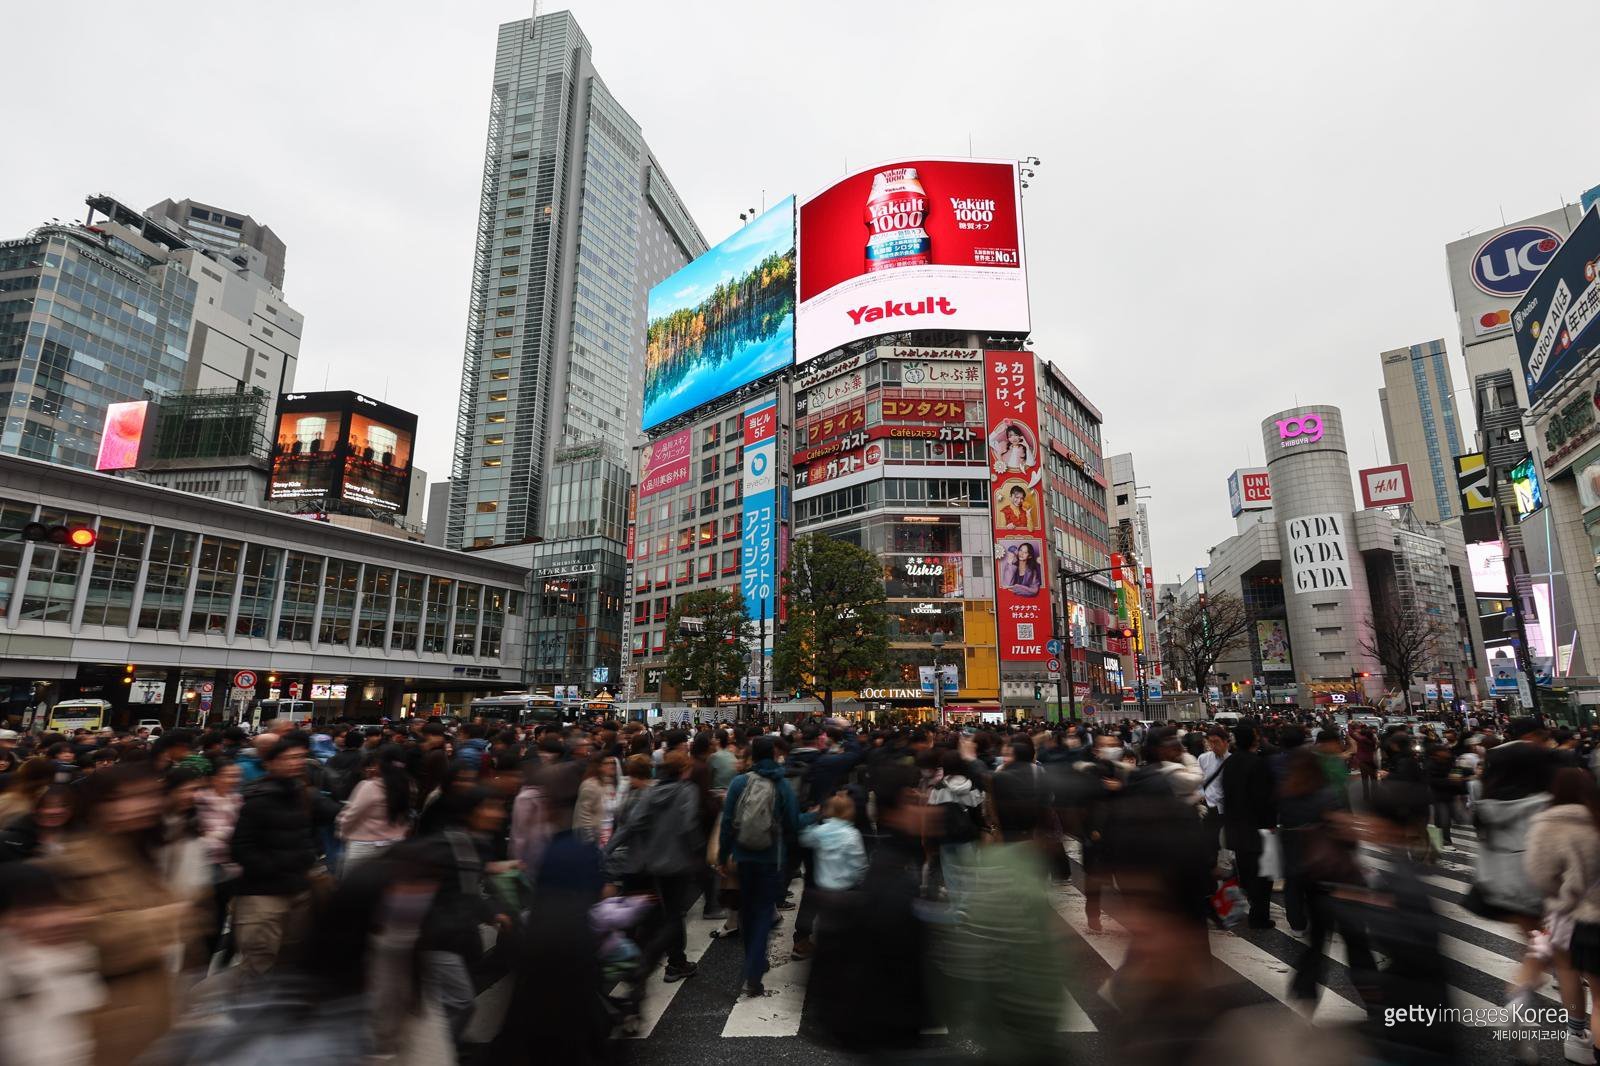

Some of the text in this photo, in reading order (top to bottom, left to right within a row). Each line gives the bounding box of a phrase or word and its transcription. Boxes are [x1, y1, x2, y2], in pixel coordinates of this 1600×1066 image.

[869, 198, 924, 217] Yakult
[949, 197, 996, 211] Yakult
[870, 211, 923, 234] 1000
[953, 209, 993, 222] 1000
[995, 250, 1017, 263] No.1
[846, 296, 958, 326] Yakult
[1521, 297, 1538, 320] Notion
[893, 348, 978, 359] しゃぶしゃぶバイキング
[1530, 325, 1555, 377] Notion
[929, 366, 980, 382] しゃぶ葉
[827, 374, 862, 399] しゃぶ葉
[1011, 361, 1026, 413] カワイイ
[797, 400, 807, 411] 9F
[882, 401, 963, 417] コンタクト
[749, 413, 771, 429] 当ビル
[810, 408, 865, 440] プライス
[1276, 412, 1325, 443] 109
[754, 425, 766, 438] 5F
[940, 427, 977, 441] ガスト
[841, 431, 869, 451] ガスト
[1280, 437, 1309, 448] SHIBUYA
[827, 455, 861, 480] ガスト
[795, 471, 808, 484] 7F
[1246, 476, 1269, 487] UNI
[1374, 478, 1398, 493] H&M
[1290, 516, 1341, 540] GYDA
[745, 510, 759, 600] アイシティ
[760, 507, 770, 598] コンタクトの
[1293, 541, 1345, 565] GYDA
[538, 563, 597, 576] MARK CITY
[905, 564, 943, 576] Ushi8
[1297, 566, 1349, 590] GYDA
